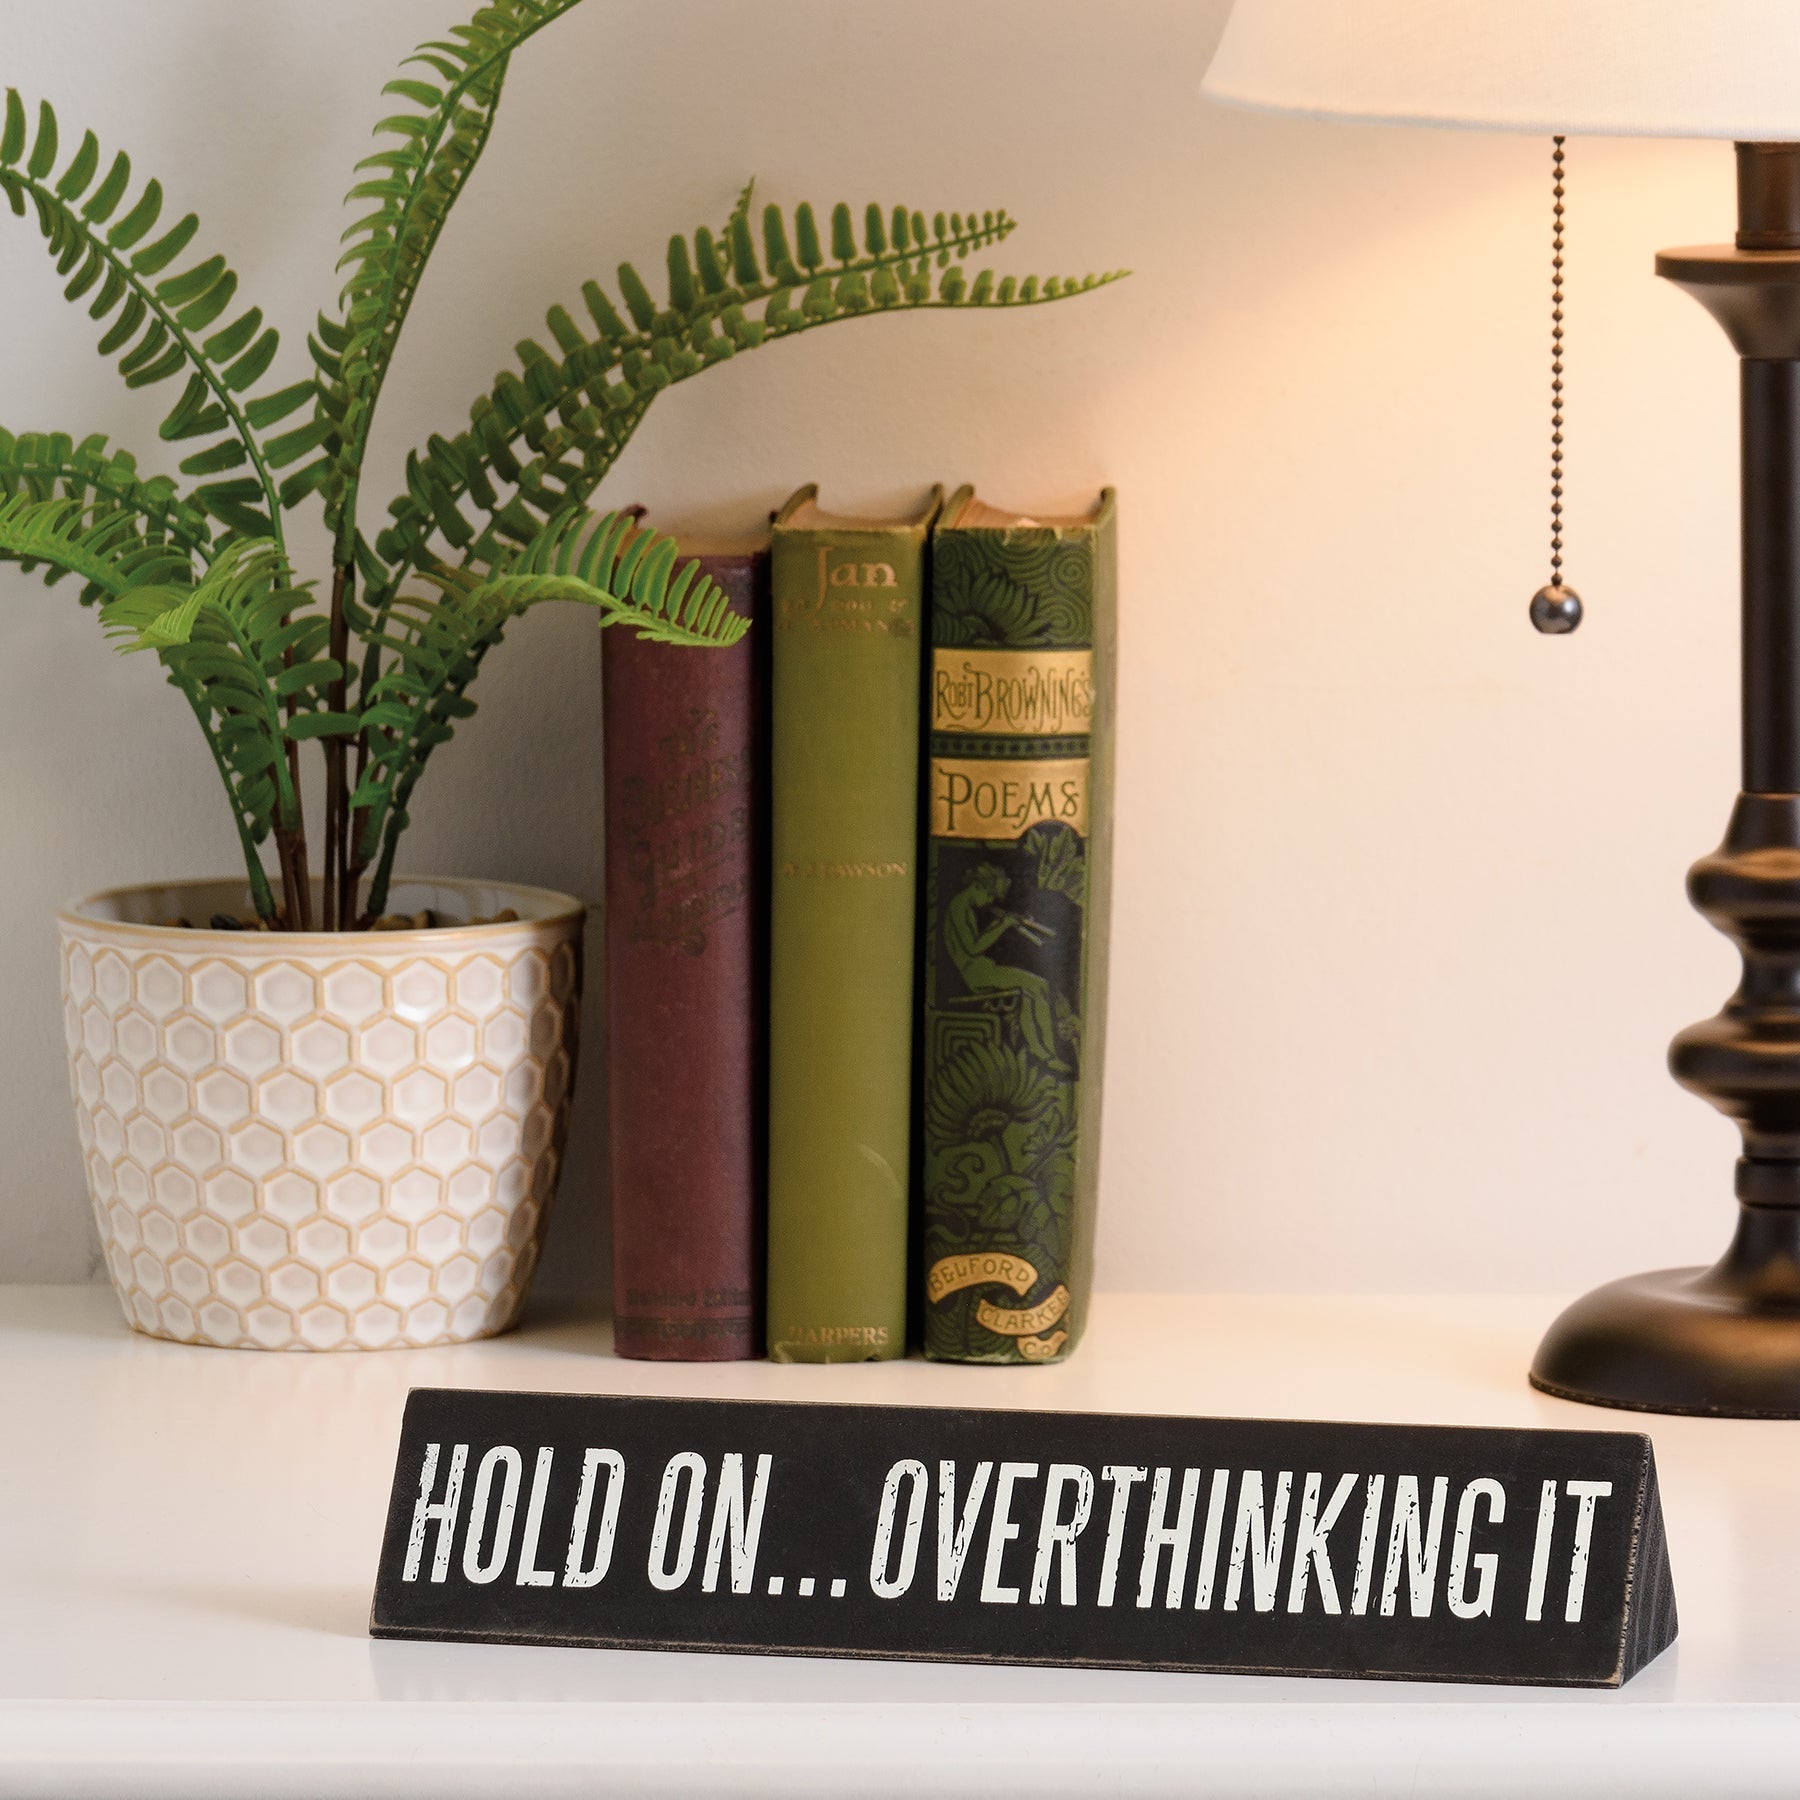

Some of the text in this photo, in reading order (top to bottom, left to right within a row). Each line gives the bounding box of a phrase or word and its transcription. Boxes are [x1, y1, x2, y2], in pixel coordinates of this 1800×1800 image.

[807, 546, 898, 616] Jan
[930, 1257, 1031, 1293] BELFORD
[402, 1443, 1612, 1622] HOLD ON... OVERTHINKING IT
